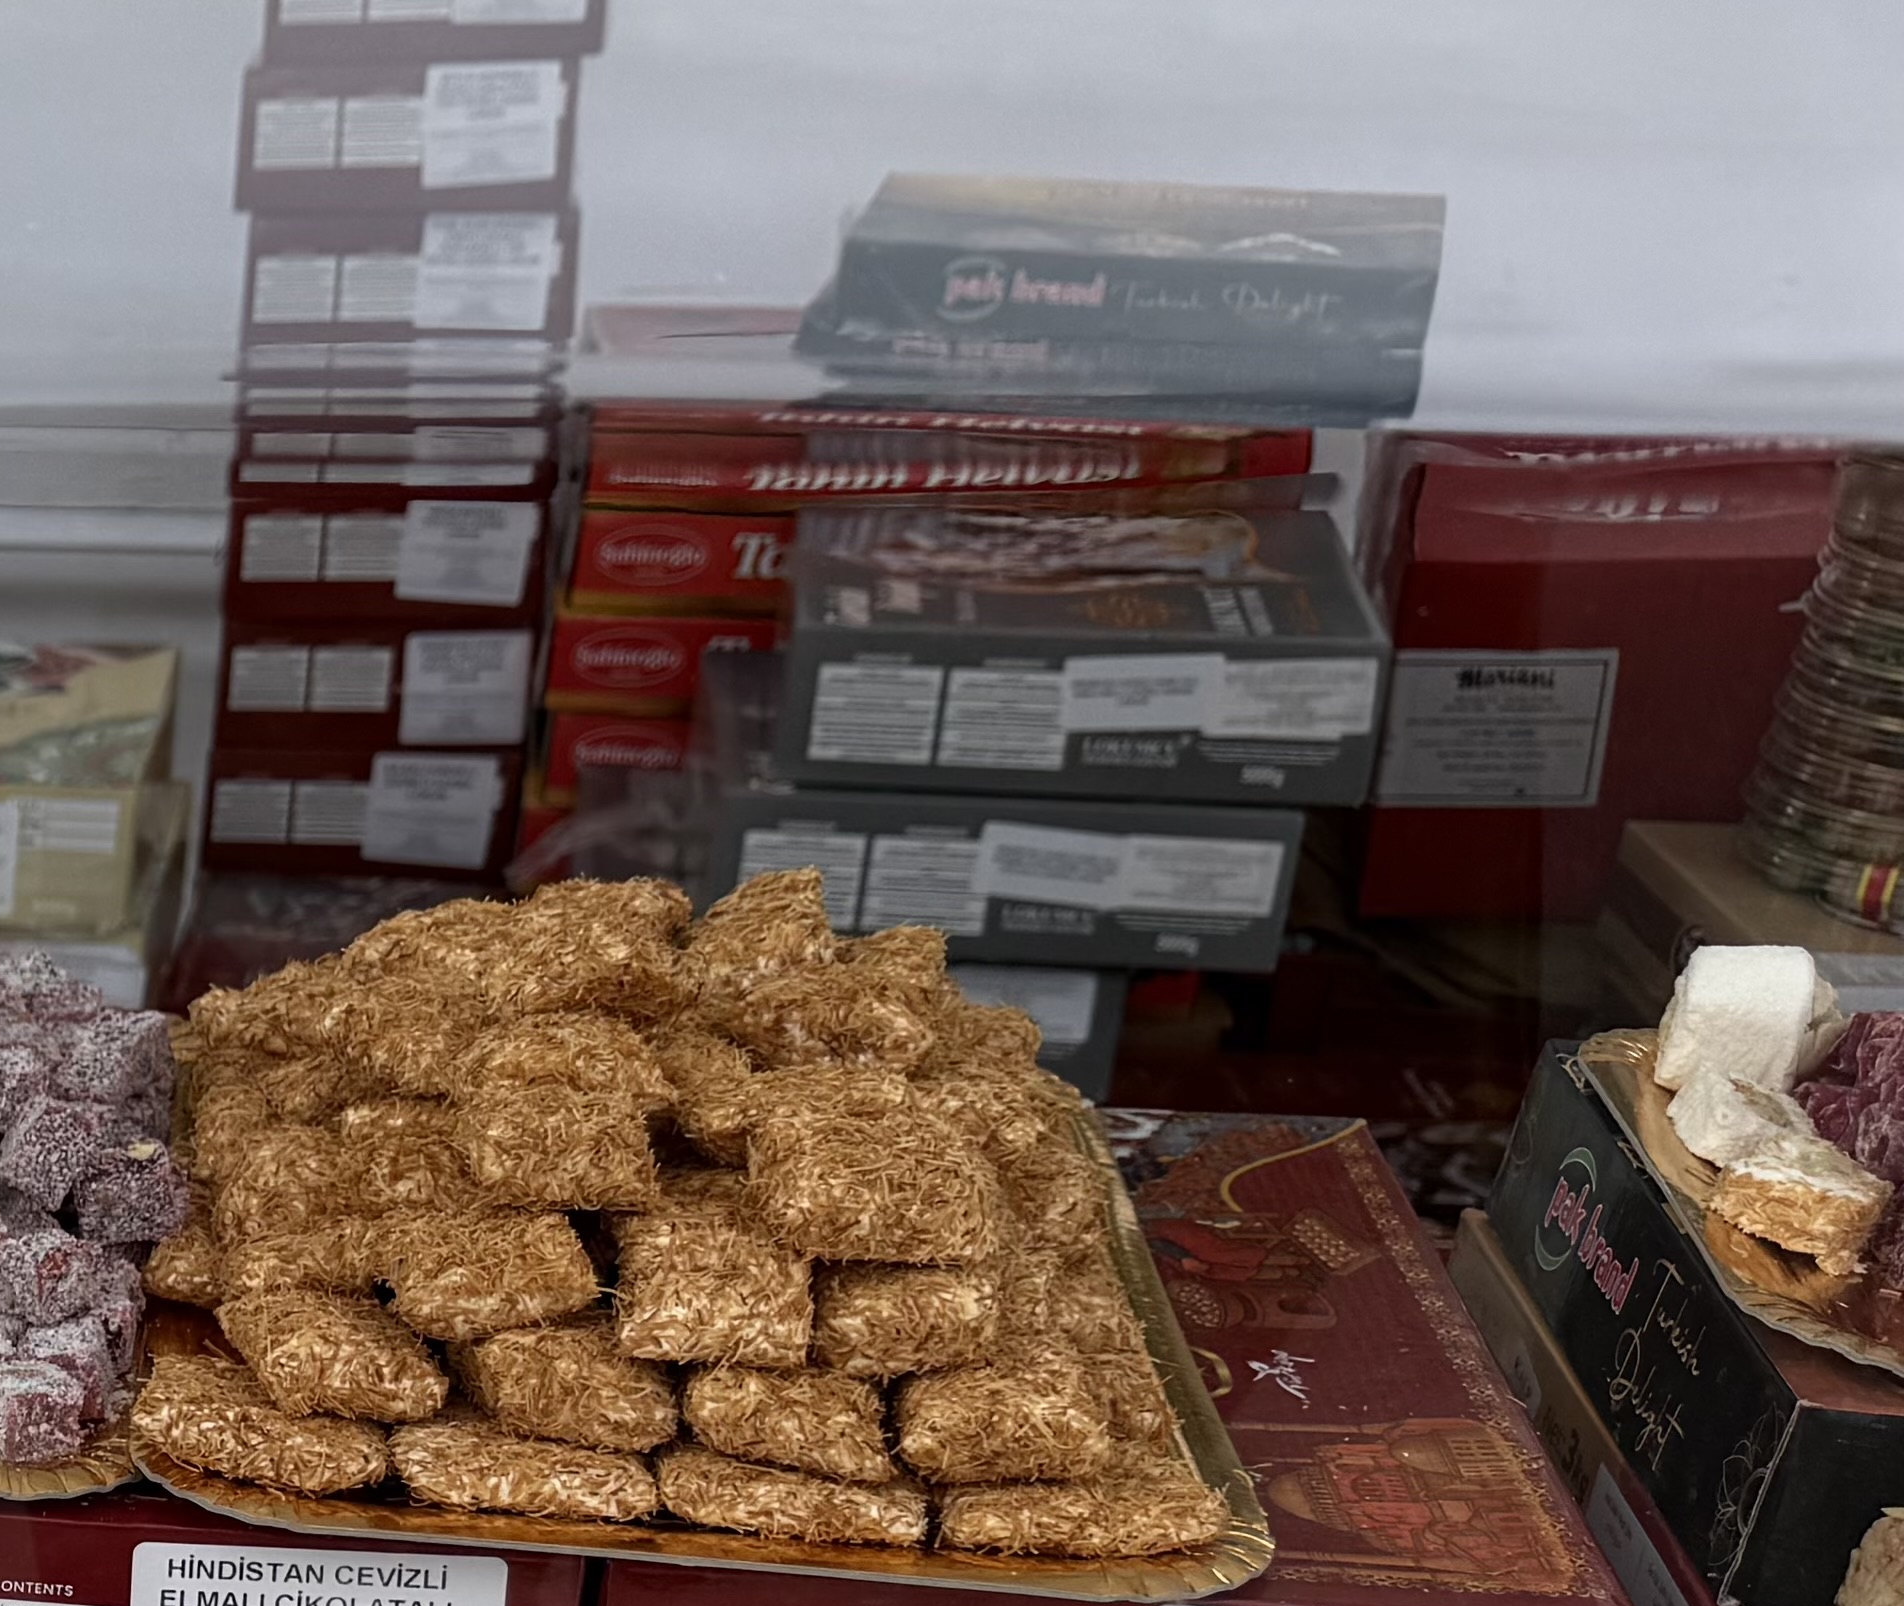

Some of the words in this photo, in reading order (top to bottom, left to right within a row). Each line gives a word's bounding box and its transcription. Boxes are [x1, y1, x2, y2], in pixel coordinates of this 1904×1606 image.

[1544, 1176, 1590, 1246] pak
[1577, 1203, 1640, 1315] brand
[1642, 1257, 1706, 1377] Turkish
[1608, 1327, 1685, 1471] Delight
[167, 1553, 325, 1585] HİNDİSTAN
[333, 1559, 449, 1590] CEVİZLİ
